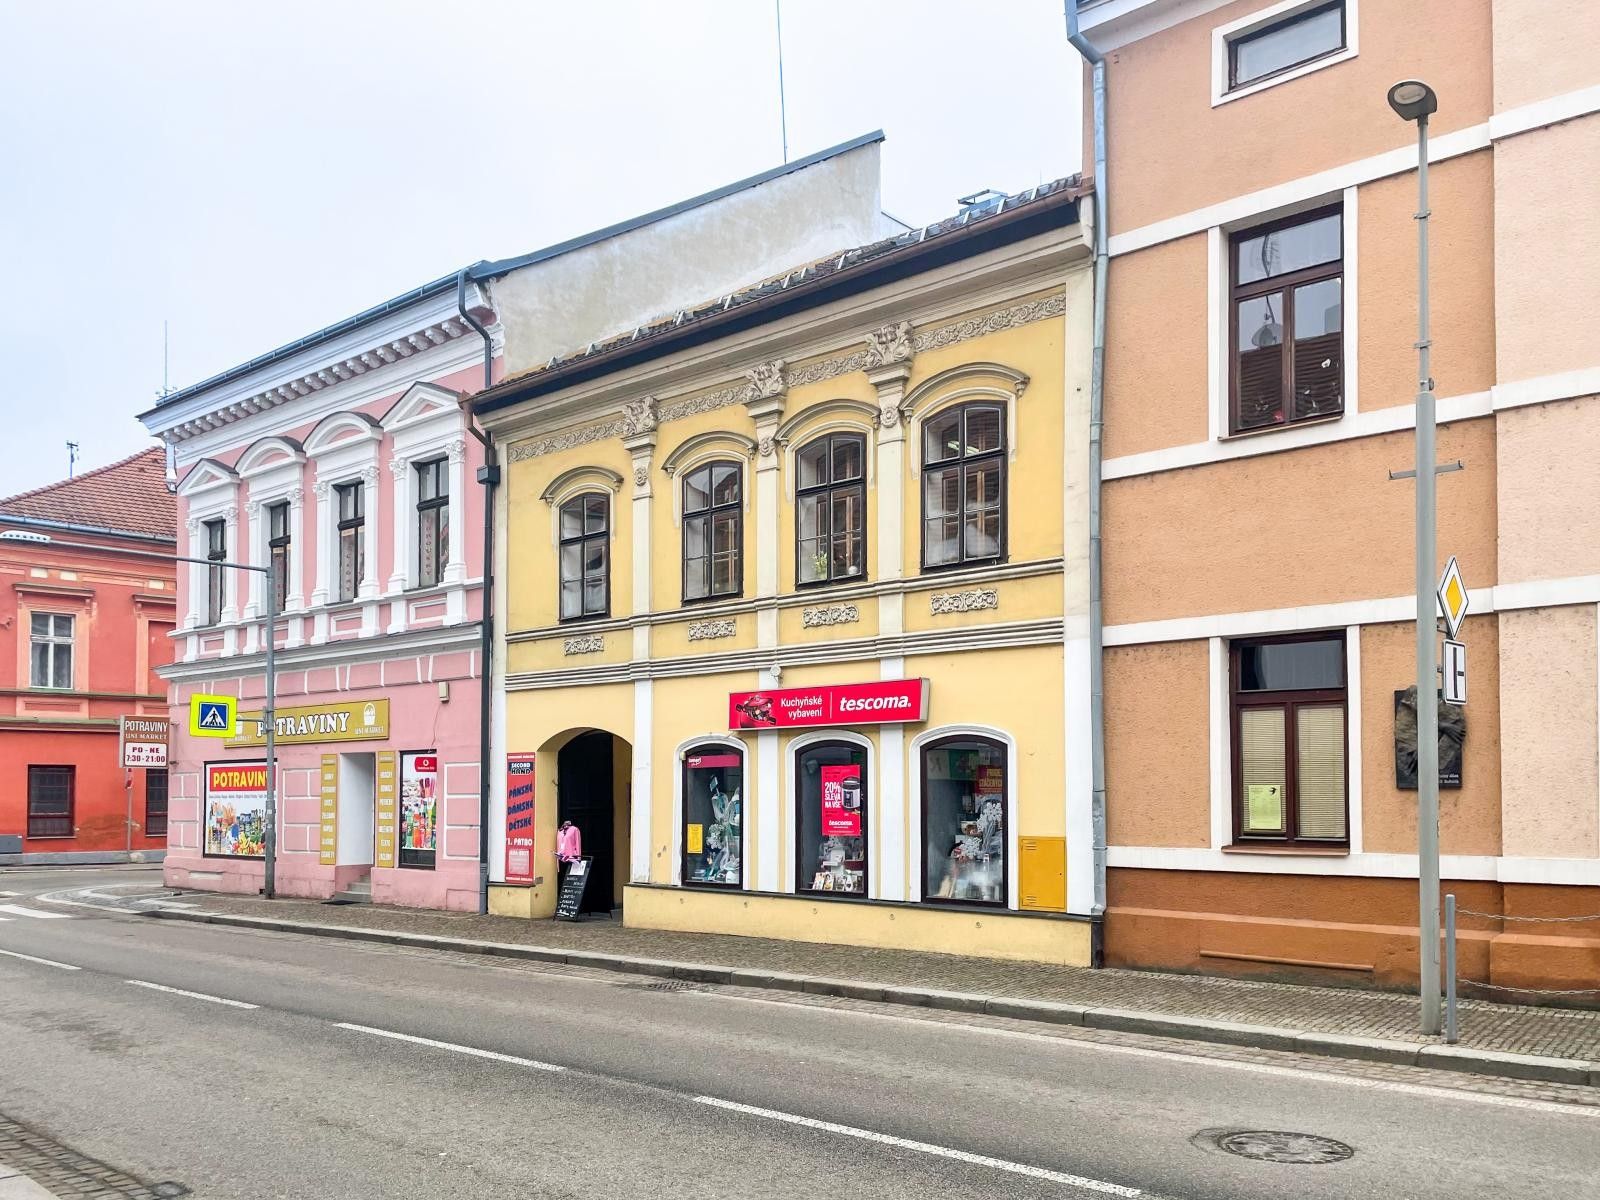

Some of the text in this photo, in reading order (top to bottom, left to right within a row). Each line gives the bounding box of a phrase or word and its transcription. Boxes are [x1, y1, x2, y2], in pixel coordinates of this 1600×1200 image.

[780, 695, 823, 708] Kuchyňské
[788, 706, 823, 720] vybavení
[125, 720, 168, 732] POTRAVINY
[256, 712, 350, 737] PTRAVINY
[213, 771, 268, 788] POTRAVIN
[824, 781, 841, 794] 20%
[824, 793, 842, 801] SLEVA
[824, 800, 833, 809] NA
[507, 837, 533, 847] 1. PATRO
